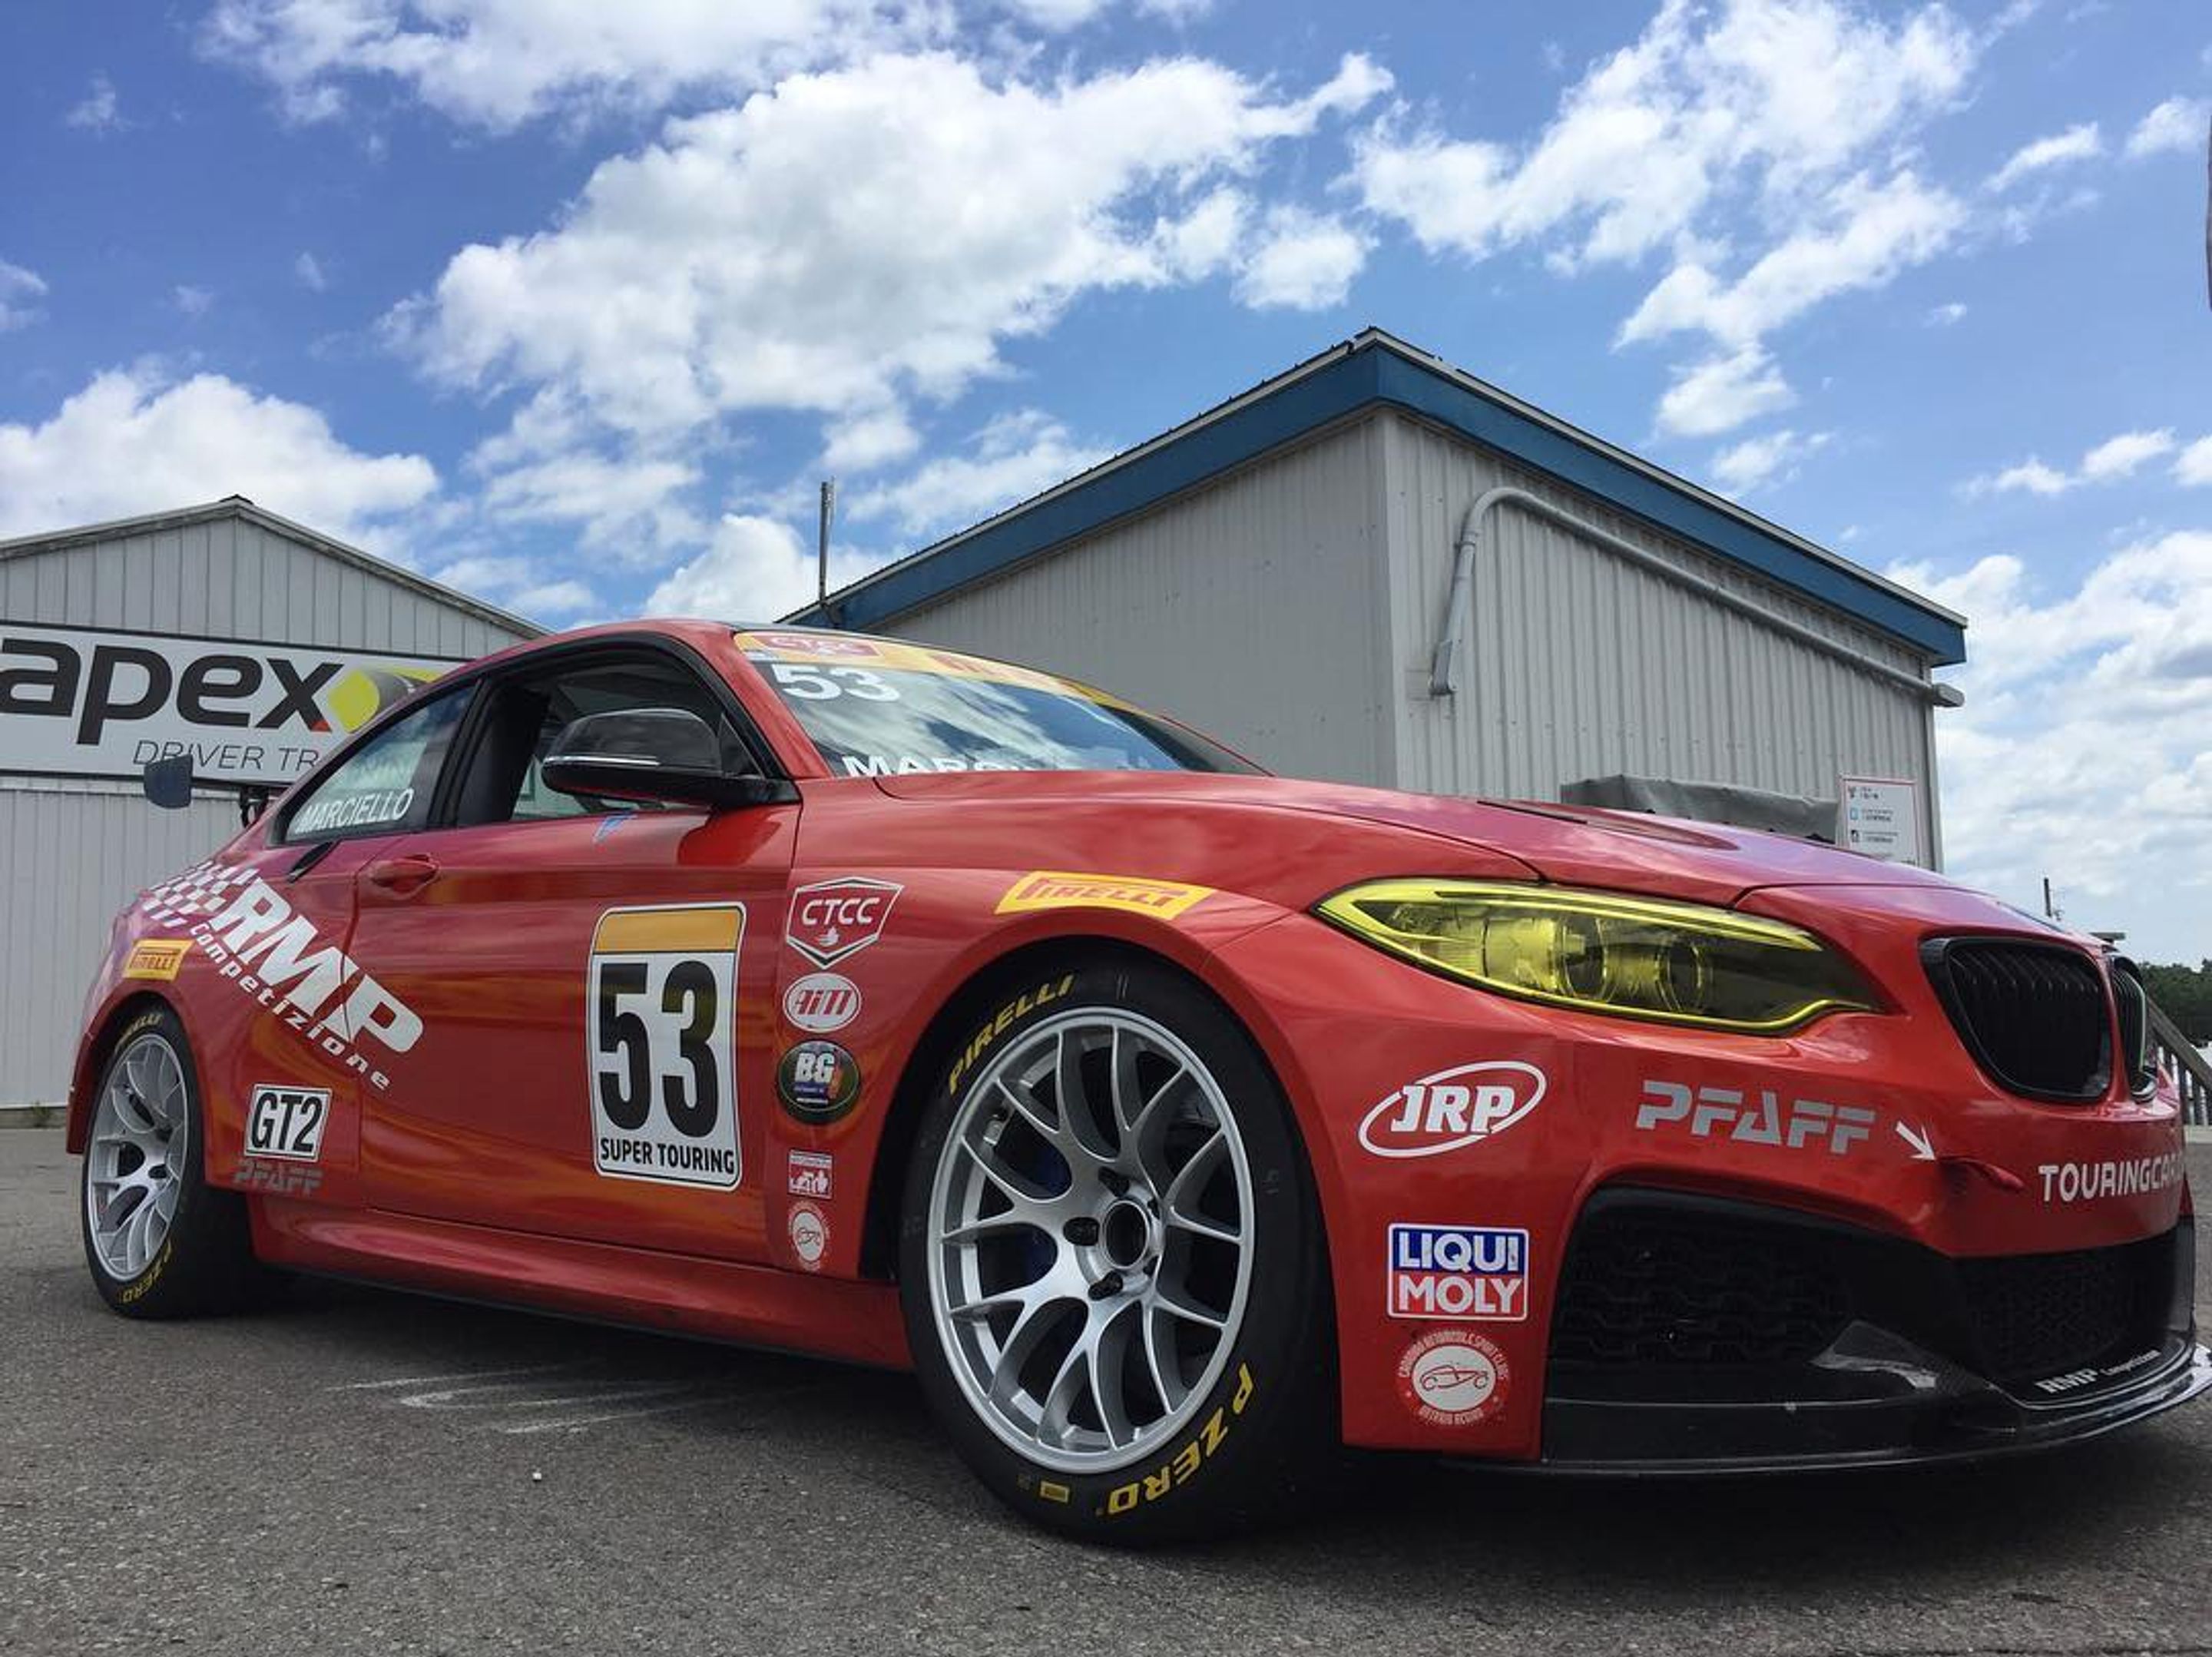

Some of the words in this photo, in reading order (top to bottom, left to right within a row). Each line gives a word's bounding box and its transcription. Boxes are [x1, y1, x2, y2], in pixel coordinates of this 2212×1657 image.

[1, 638, 344, 745] apex
[770, 664, 900, 702] 53
[278, 747, 320, 771] TR
[294, 788, 415, 834] MARCIELLO
[801, 896, 880, 925] CTCC
[1015, 877, 1188, 908] PIRELLI
[207, 877, 425, 1053] RMP
[600, 960, 719, 1138] 53
[948, 973, 1075, 1097] PIRELLI
[795, 1052, 835, 1083] BG
[250, 1092, 323, 1152] GT2
[1390, 1085, 1515, 1135] JRP
[1636, 1079, 1876, 1155] PFAFF
[600, 1137, 652, 1166] SUPER
[658, 1143, 735, 1175] TOURING
[1399, 1232, 1519, 1273] LIQUI
[1399, 1273, 1522, 1314] MOLY
[1233, 1362, 1253, 1415] P
[1108, 1407, 1228, 1515] ZERO
